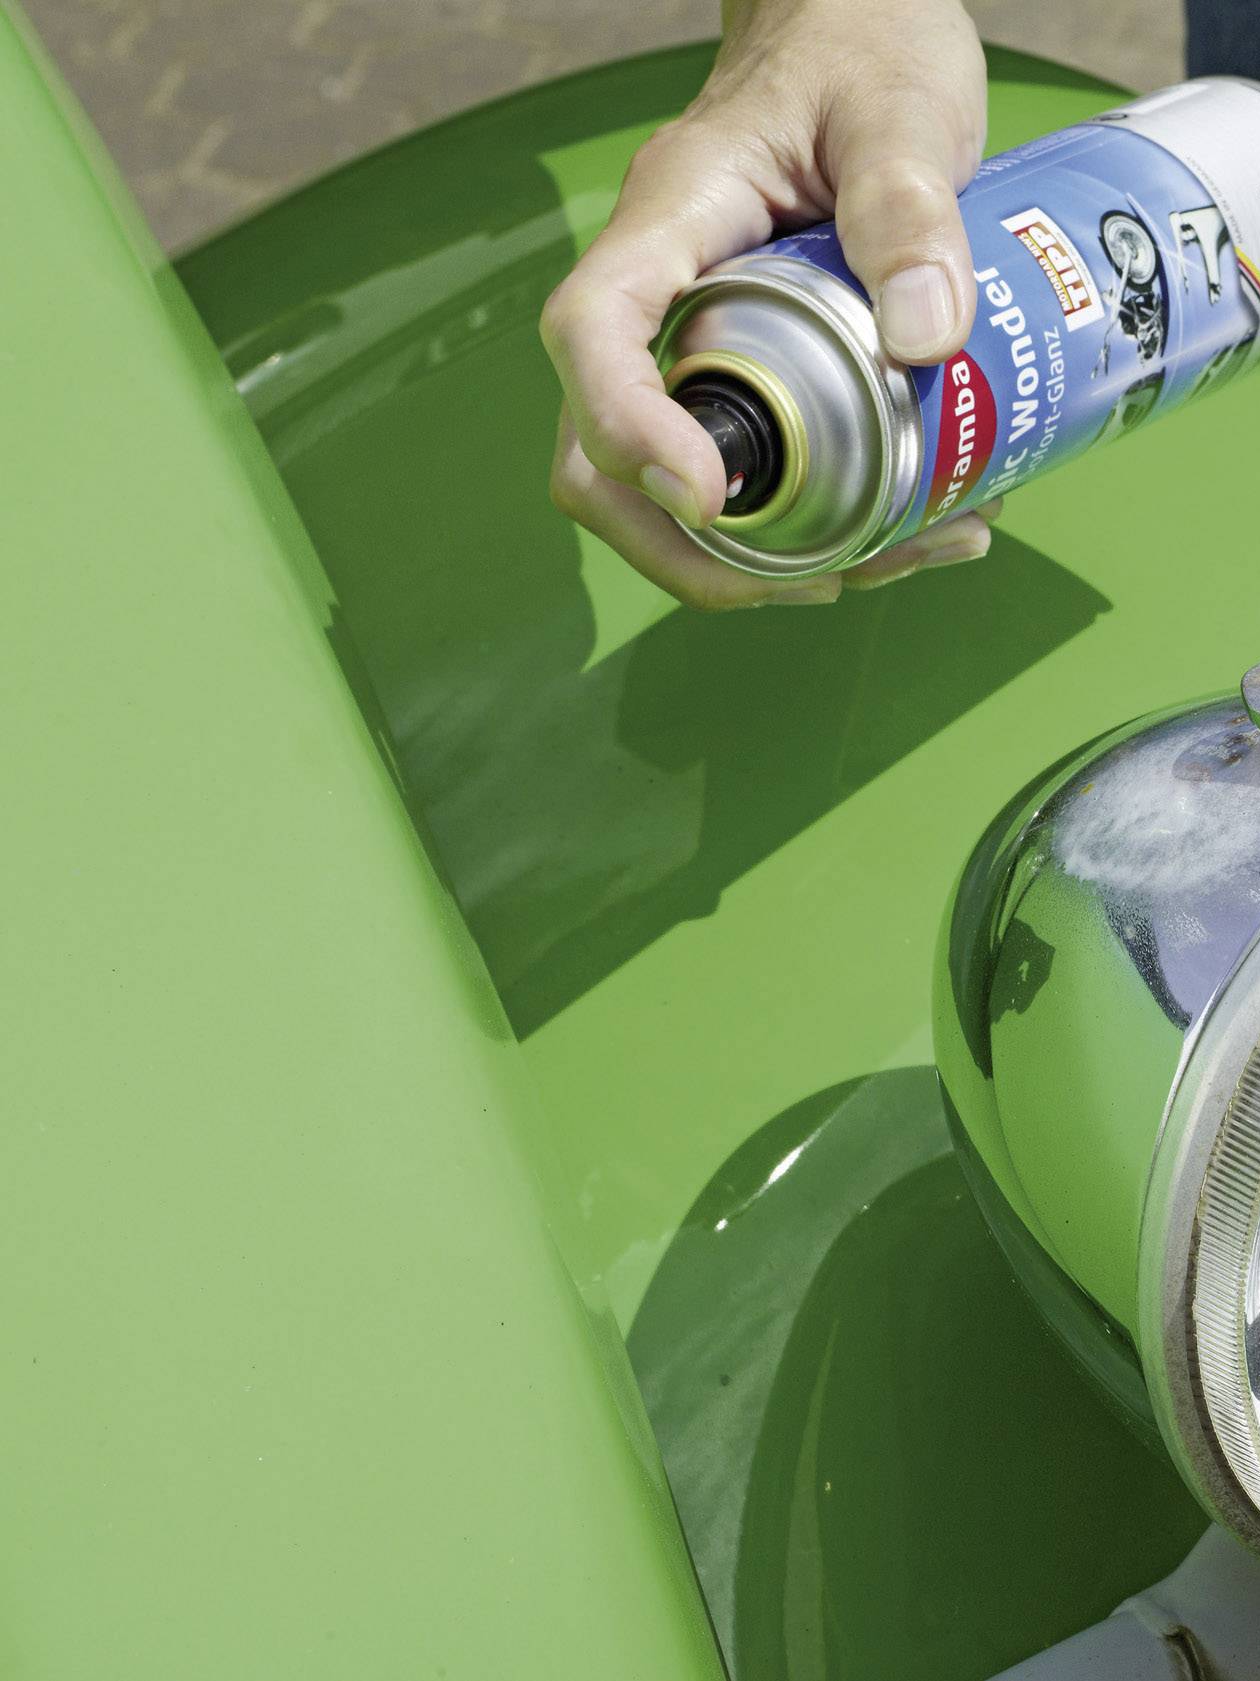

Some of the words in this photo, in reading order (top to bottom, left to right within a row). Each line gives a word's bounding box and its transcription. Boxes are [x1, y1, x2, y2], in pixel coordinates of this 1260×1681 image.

[1018, 232, 1044, 257] NEWS
[1028, 226, 1088, 309] TIPP
[1036, 258, 1074, 312] MOTORRAD
[973, 266, 1040, 444] Wonder
